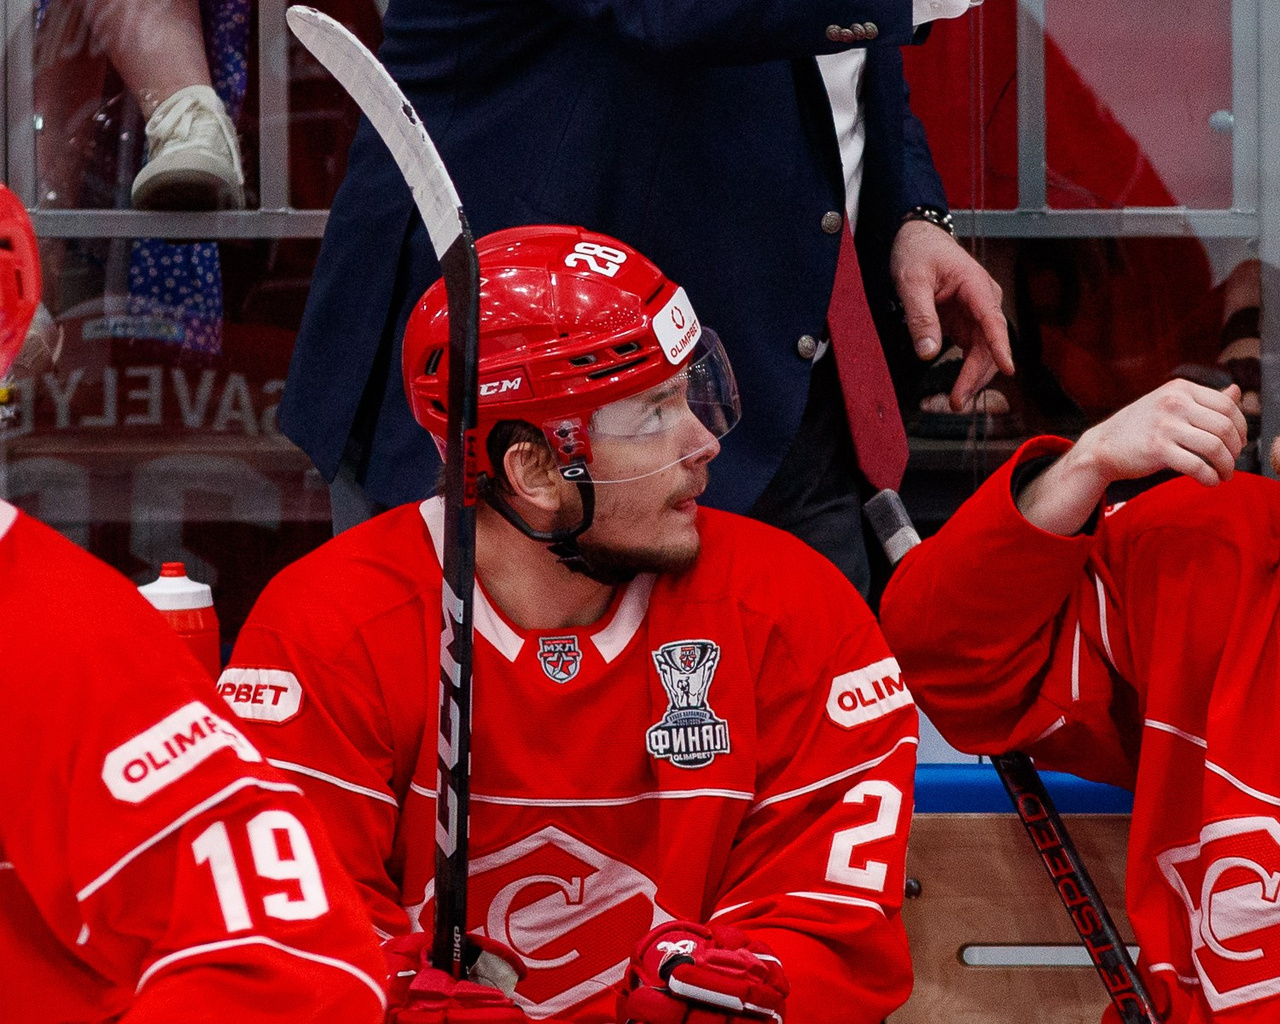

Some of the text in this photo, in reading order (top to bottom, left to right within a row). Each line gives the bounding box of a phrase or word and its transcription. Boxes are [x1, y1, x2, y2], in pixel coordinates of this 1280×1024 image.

[564, 241, 628, 277] 28
[670, 320, 699, 358] OLIMPBET
[479, 377, 522, 396] CM
[217, 682, 288, 706] PBET
[435, 576, 464, 859] CCM
[652, 724, 727, 754] ФИНАЛ
[191, 809, 330, 933] 19
